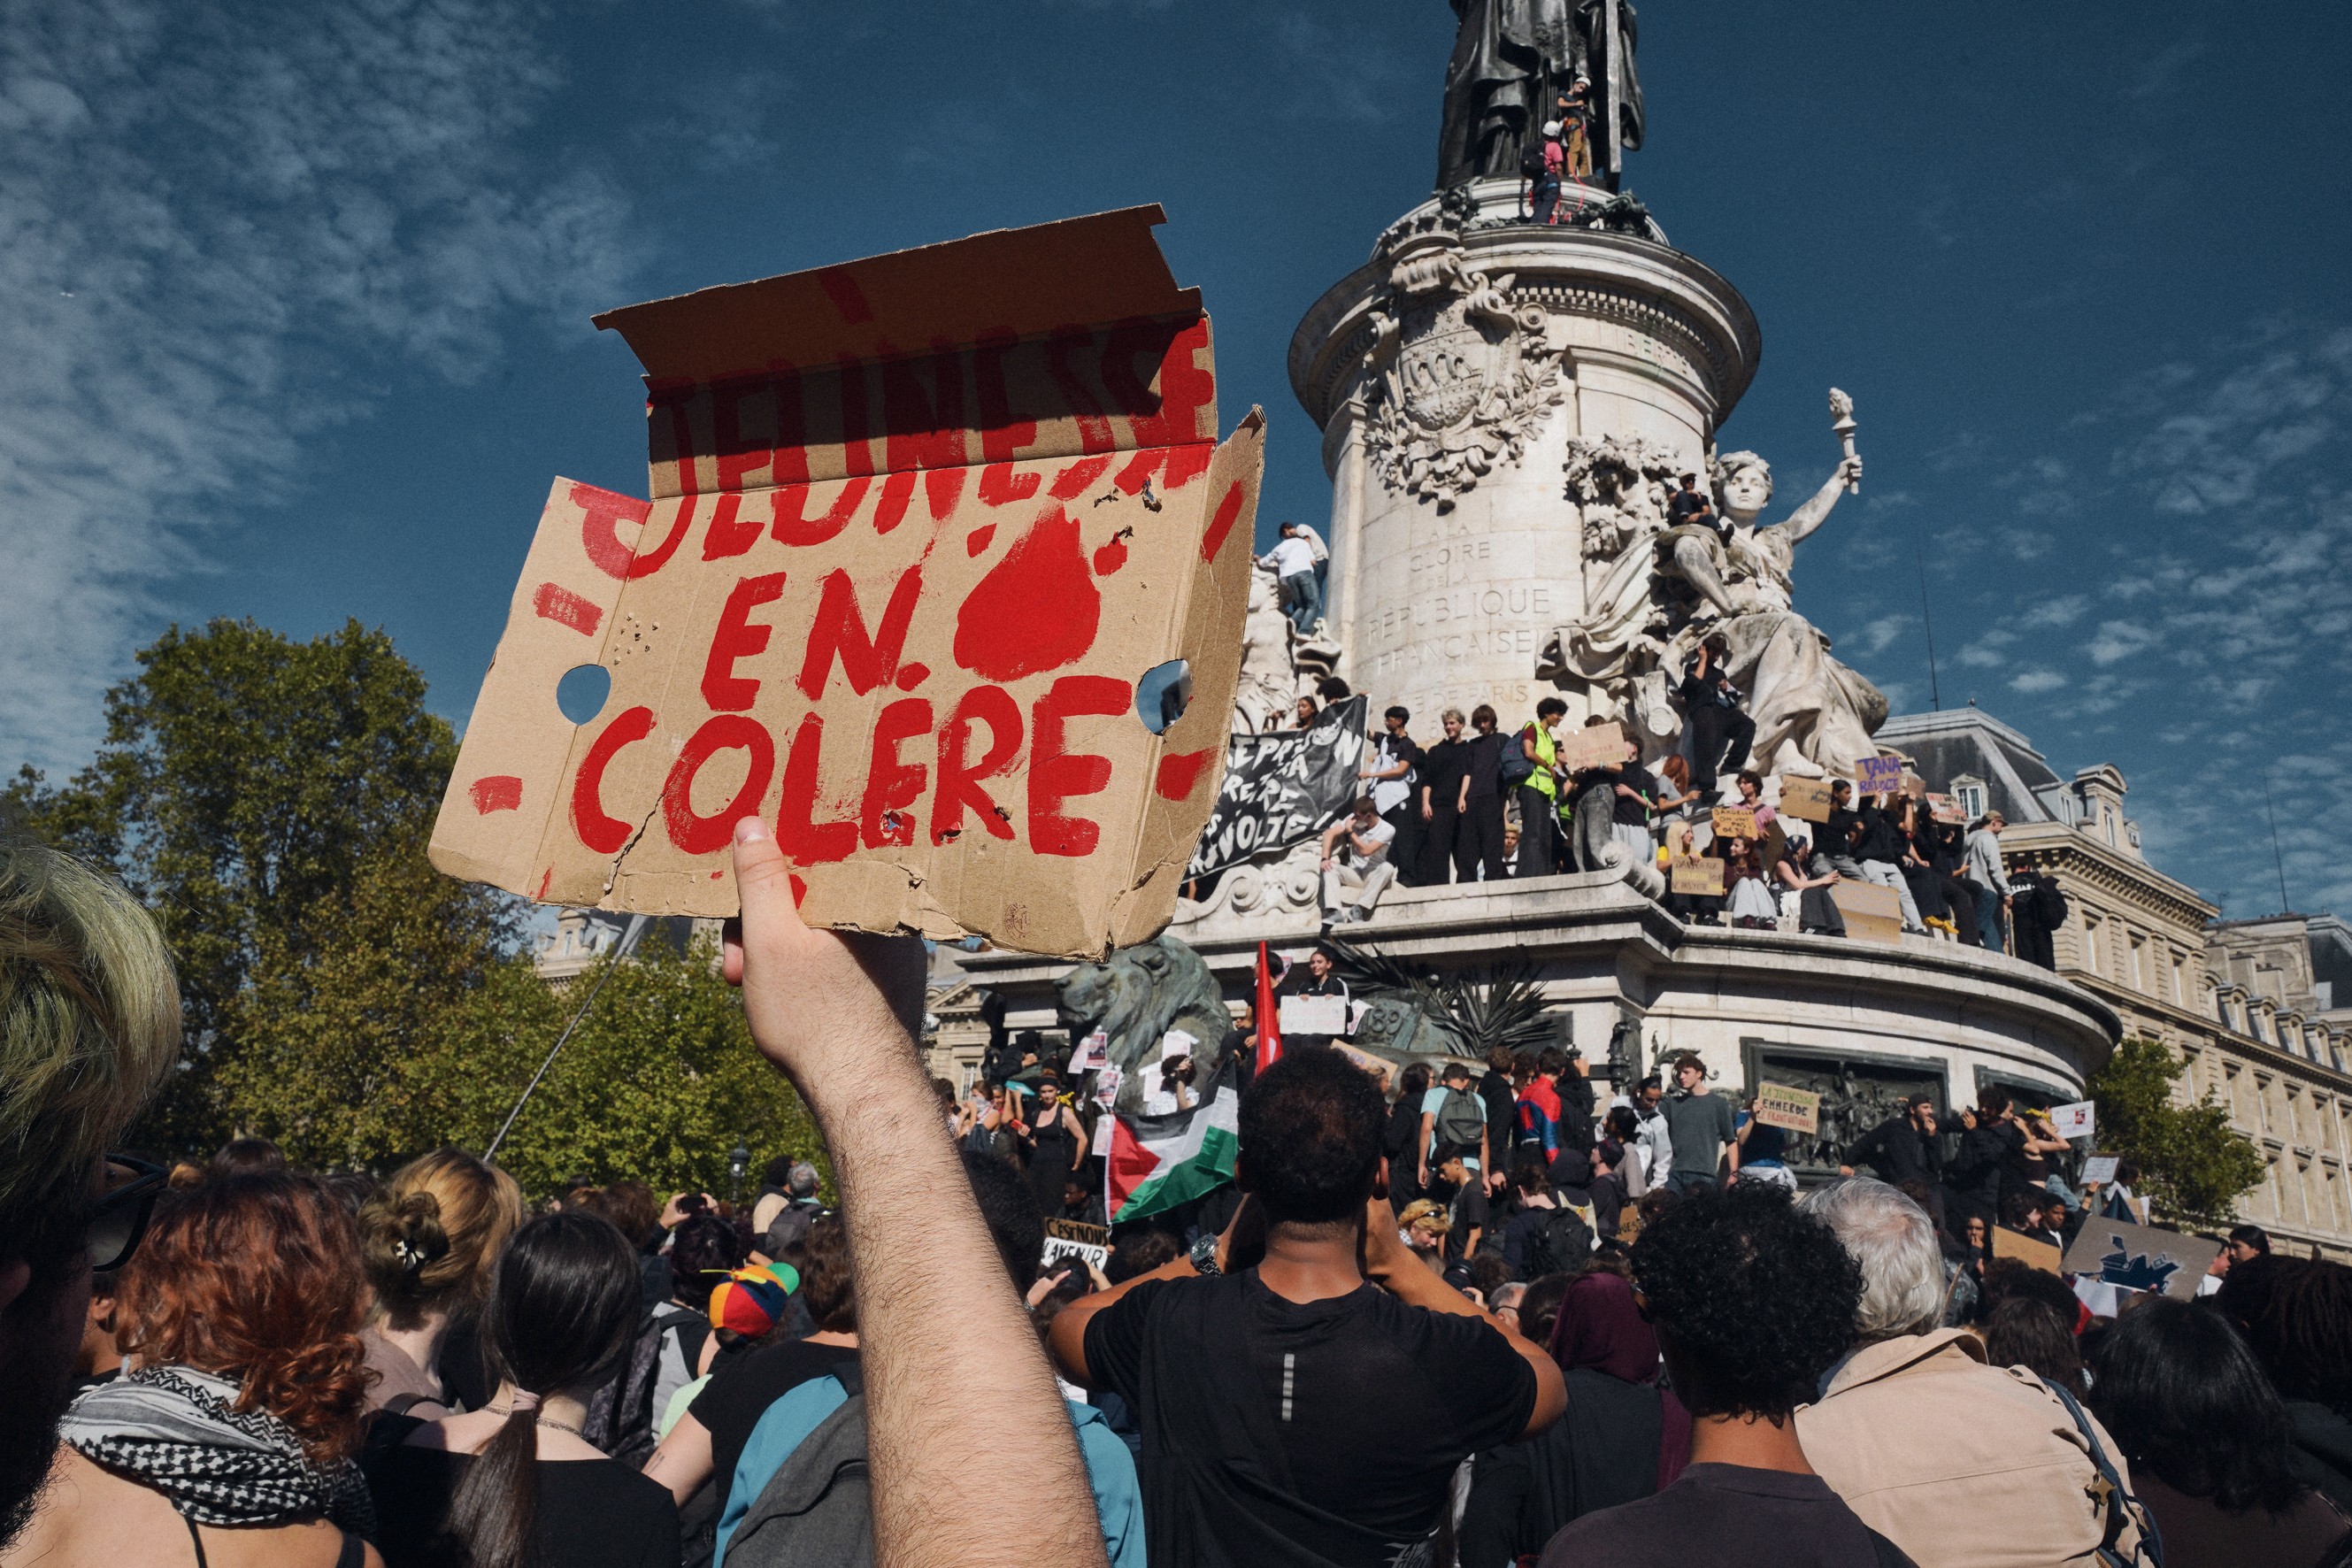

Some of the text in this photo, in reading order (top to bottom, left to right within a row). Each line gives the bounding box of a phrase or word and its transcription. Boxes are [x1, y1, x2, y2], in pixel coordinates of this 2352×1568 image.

[569, 315, 1216, 581] JEUNESSE
[1409, 541, 1491, 573] GLOIRE
[1467, 685, 1529, 708] PARIS
[1763, 1097, 1809, 1117] EMMERDE
[1047, 1218, 1076, 1241] C'EST
